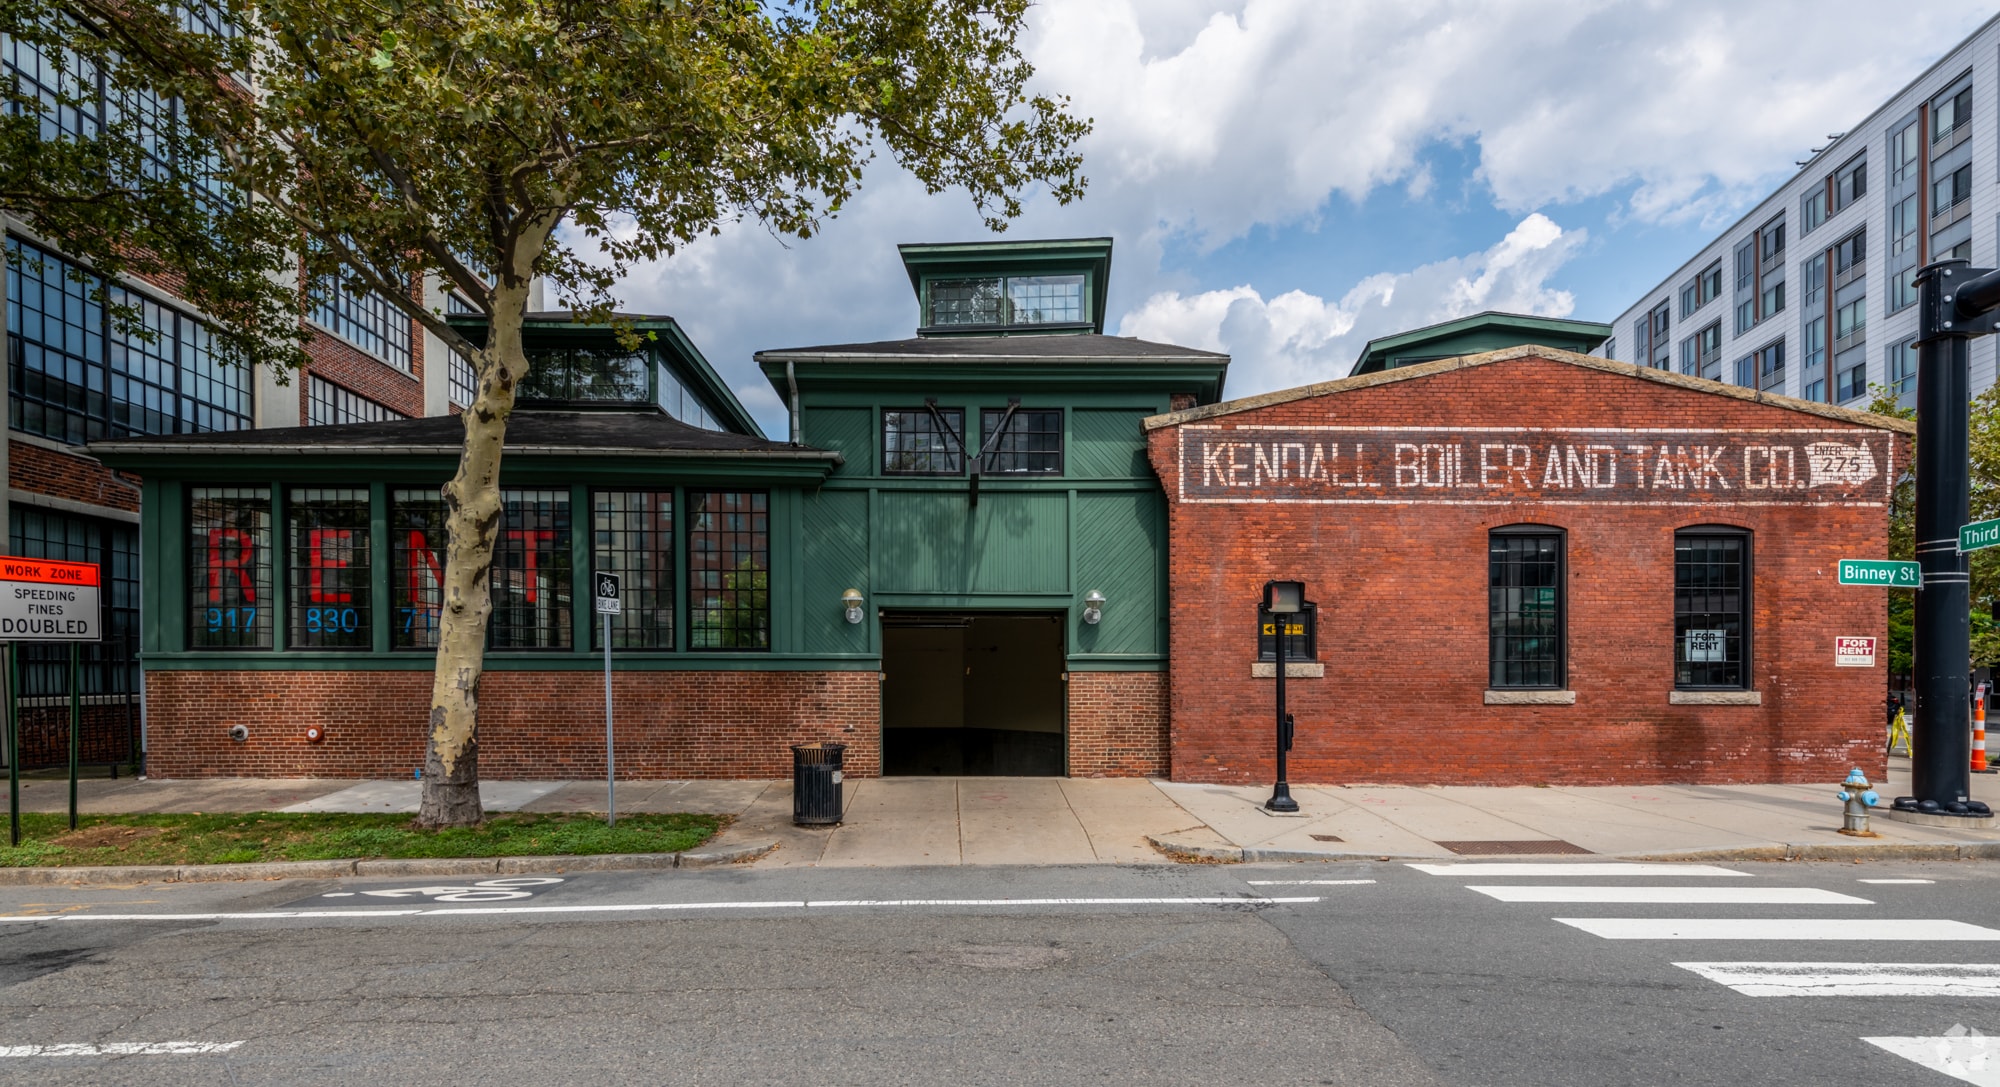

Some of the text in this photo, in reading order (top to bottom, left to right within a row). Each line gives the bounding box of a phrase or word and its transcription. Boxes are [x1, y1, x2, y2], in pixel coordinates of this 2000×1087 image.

[1814, 445, 1843, 456] ENTER
[1203, 442, 1806, 490] KENDALL BOILER AND TANK CO.
[1821, 456, 1861, 473] 275
[1965, 525, 1999, 545] Third
[4, 564, 83, 581] WORK ZONE
[1844, 565, 1916, 583] Binney St
[14, 588, 76, 602] SPEEDING
[28, 604, 64, 616] FINES
[2, 617, 88, 635] DOUBLED
[206, 607, 257, 633] 917
[306, 608, 358, 633] 830
[1694, 632, 1716, 641] FOR
[1842, 639, 1868, 648] FOR
[1691, 641, 1719, 650] RENT
[1838, 647, 1872, 655] RENT
